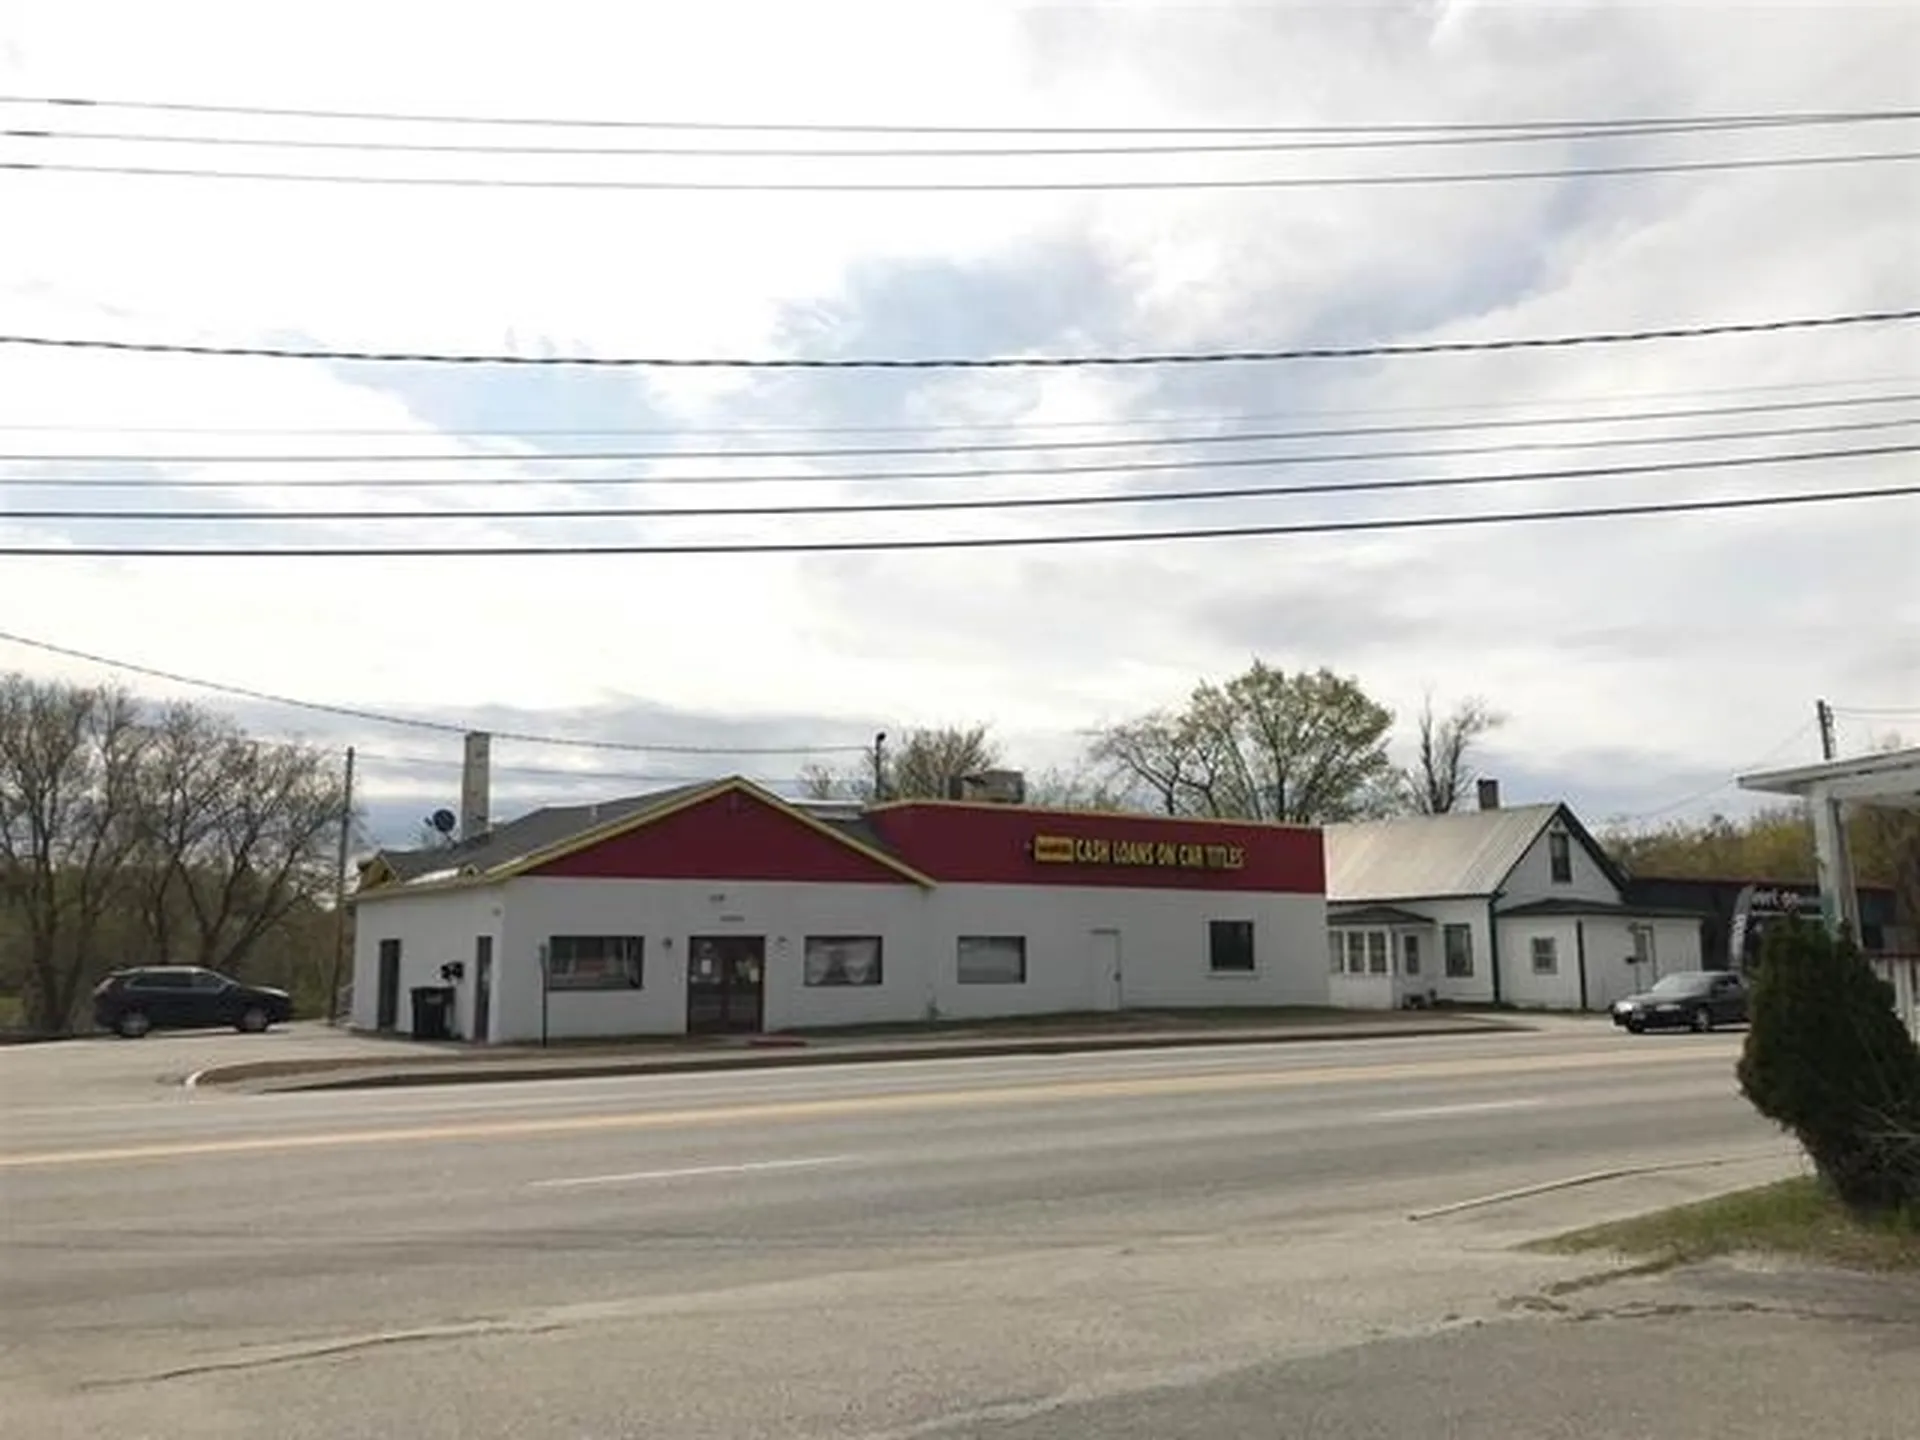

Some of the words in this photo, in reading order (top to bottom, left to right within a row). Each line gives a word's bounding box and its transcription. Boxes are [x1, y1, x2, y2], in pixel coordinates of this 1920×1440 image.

[1076, 839, 1110, 862] CASH
[1113, 840, 1153, 865] LOANS
[1157, 843, 1176, 865] ON
[1179, 844, 1203, 867] CAR
